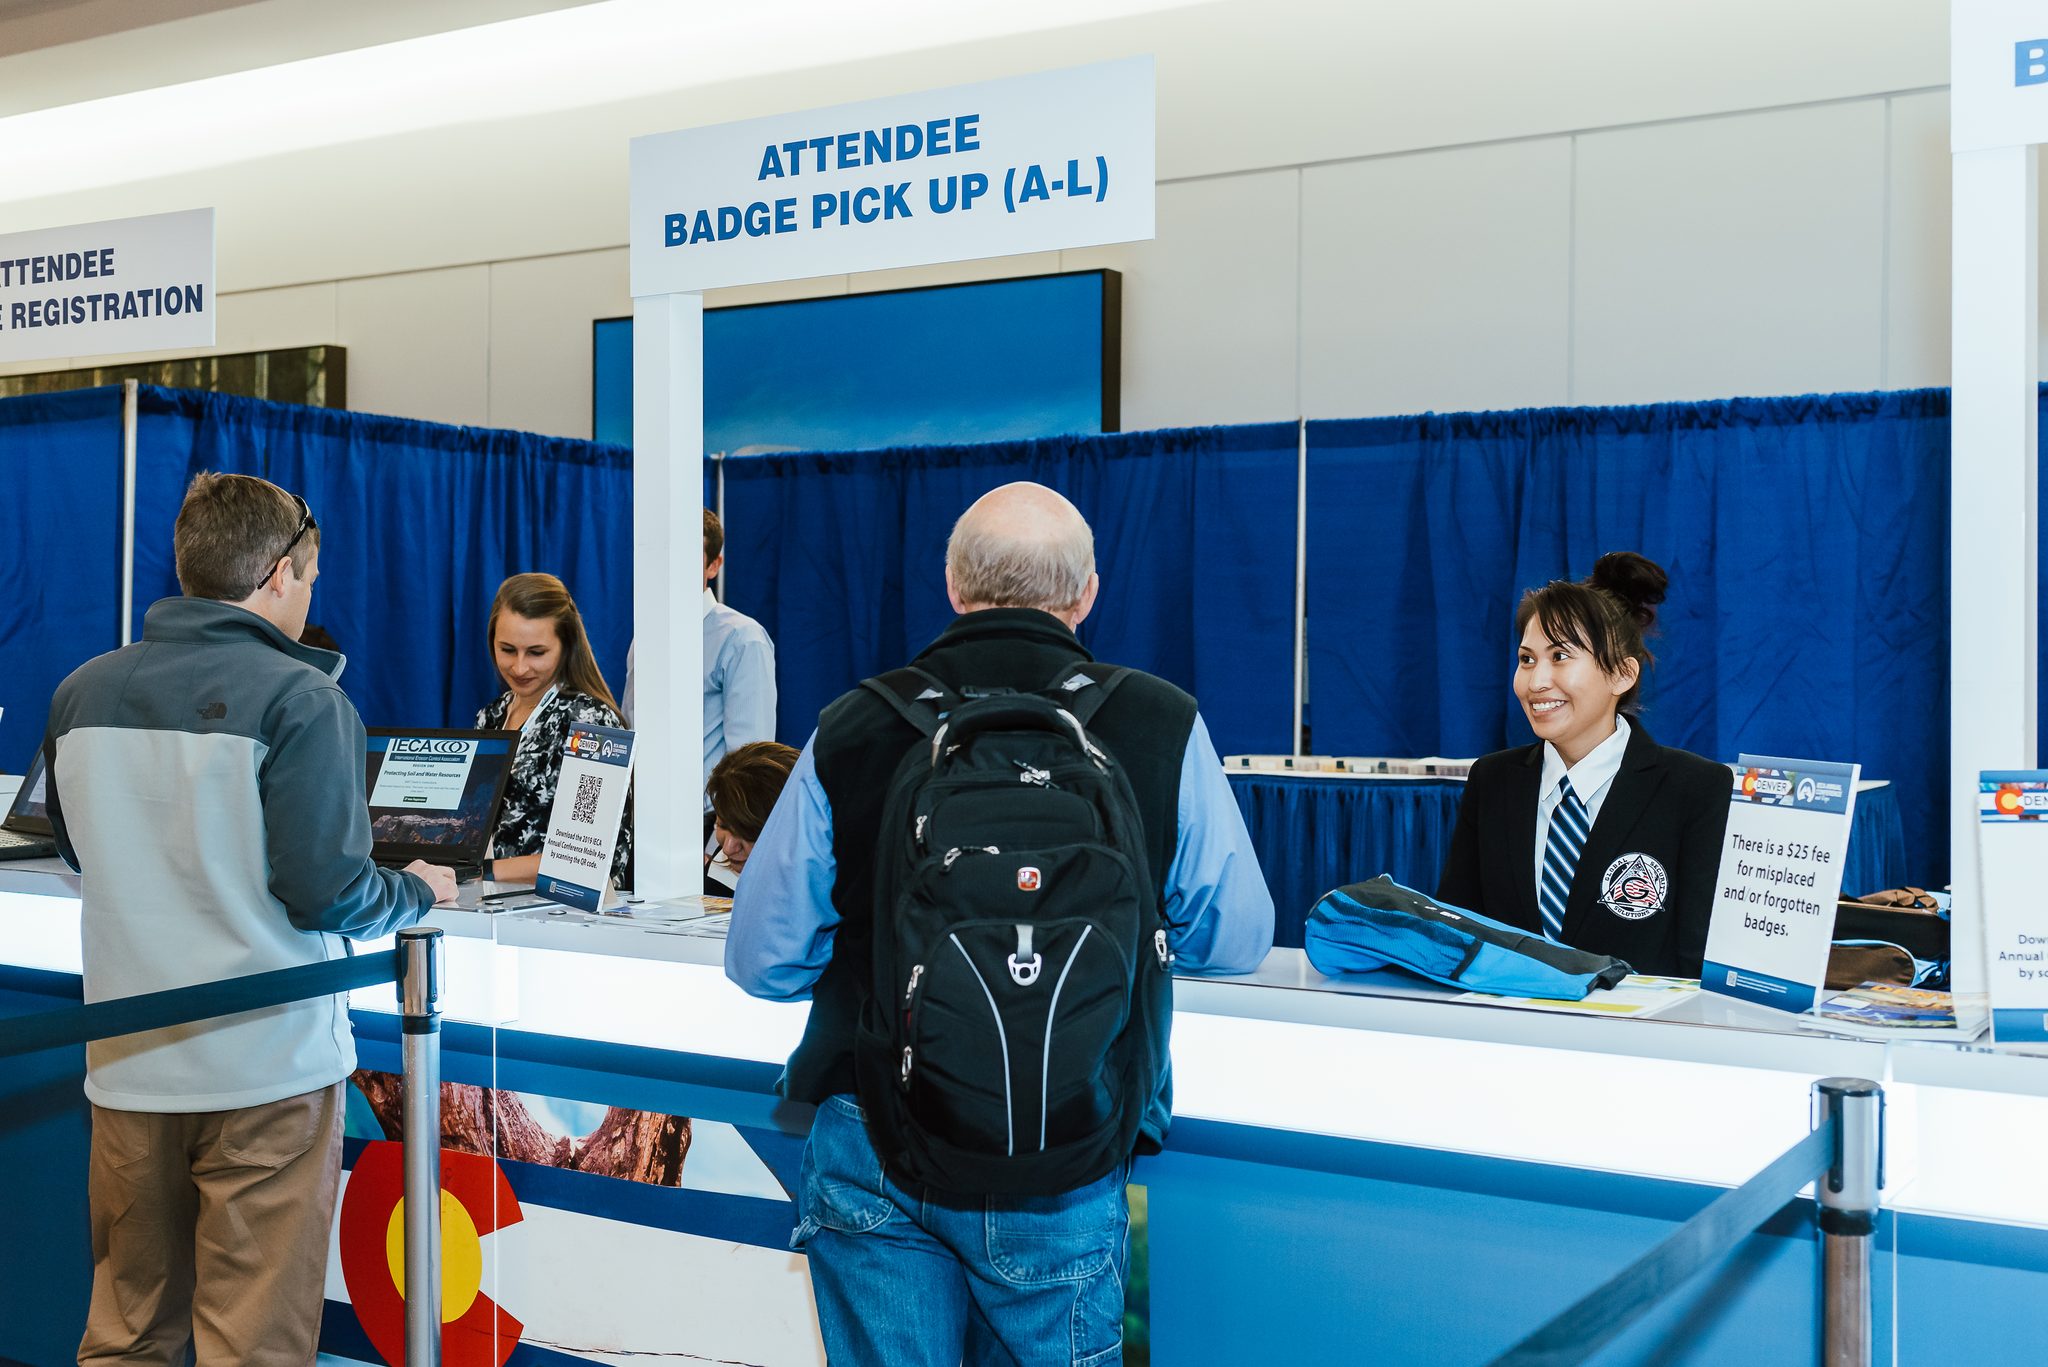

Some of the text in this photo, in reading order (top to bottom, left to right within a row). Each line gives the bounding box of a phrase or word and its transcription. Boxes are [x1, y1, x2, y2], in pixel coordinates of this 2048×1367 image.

[758, 113, 981, 181] ATTENDEE
[664, 156, 1108, 248] BADGE PICK UP (A-L)
[0, 248, 115, 288] TTENDEE
[11, 284, 203, 329] REGISTRATION
[392, 739, 432, 752] IECA
[579, 739, 597, 751] DENVER
[1756, 780, 1787, 792] DENVER
[555, 828, 576, 840] Download
[575, 833, 583, 842] the
[593, 838, 602, 846] IECA
[547, 838, 607, 860] Annual Conference Mobile App
[1732, 834, 1831, 863] There is a $25 fee
[555, 852, 573, 864] scanning
[580, 857, 587, 866] QR
[587, 860, 598, 869] code.
[1605, 858, 1627, 881] GLOBAL
[1649, 861, 1666, 897] SECURITY
[1737, 859, 1816, 887] for misplaced
[1613, 905, 1651, 918] SOLUTIONS
[1763, 890, 1821, 916] forgotten
[1744, 912, 1789, 937] badges.
[2018, 934, 2048, 945] Dow
[1999, 950, 2044, 961] Annual
[2018, 967, 2034, 980] by
